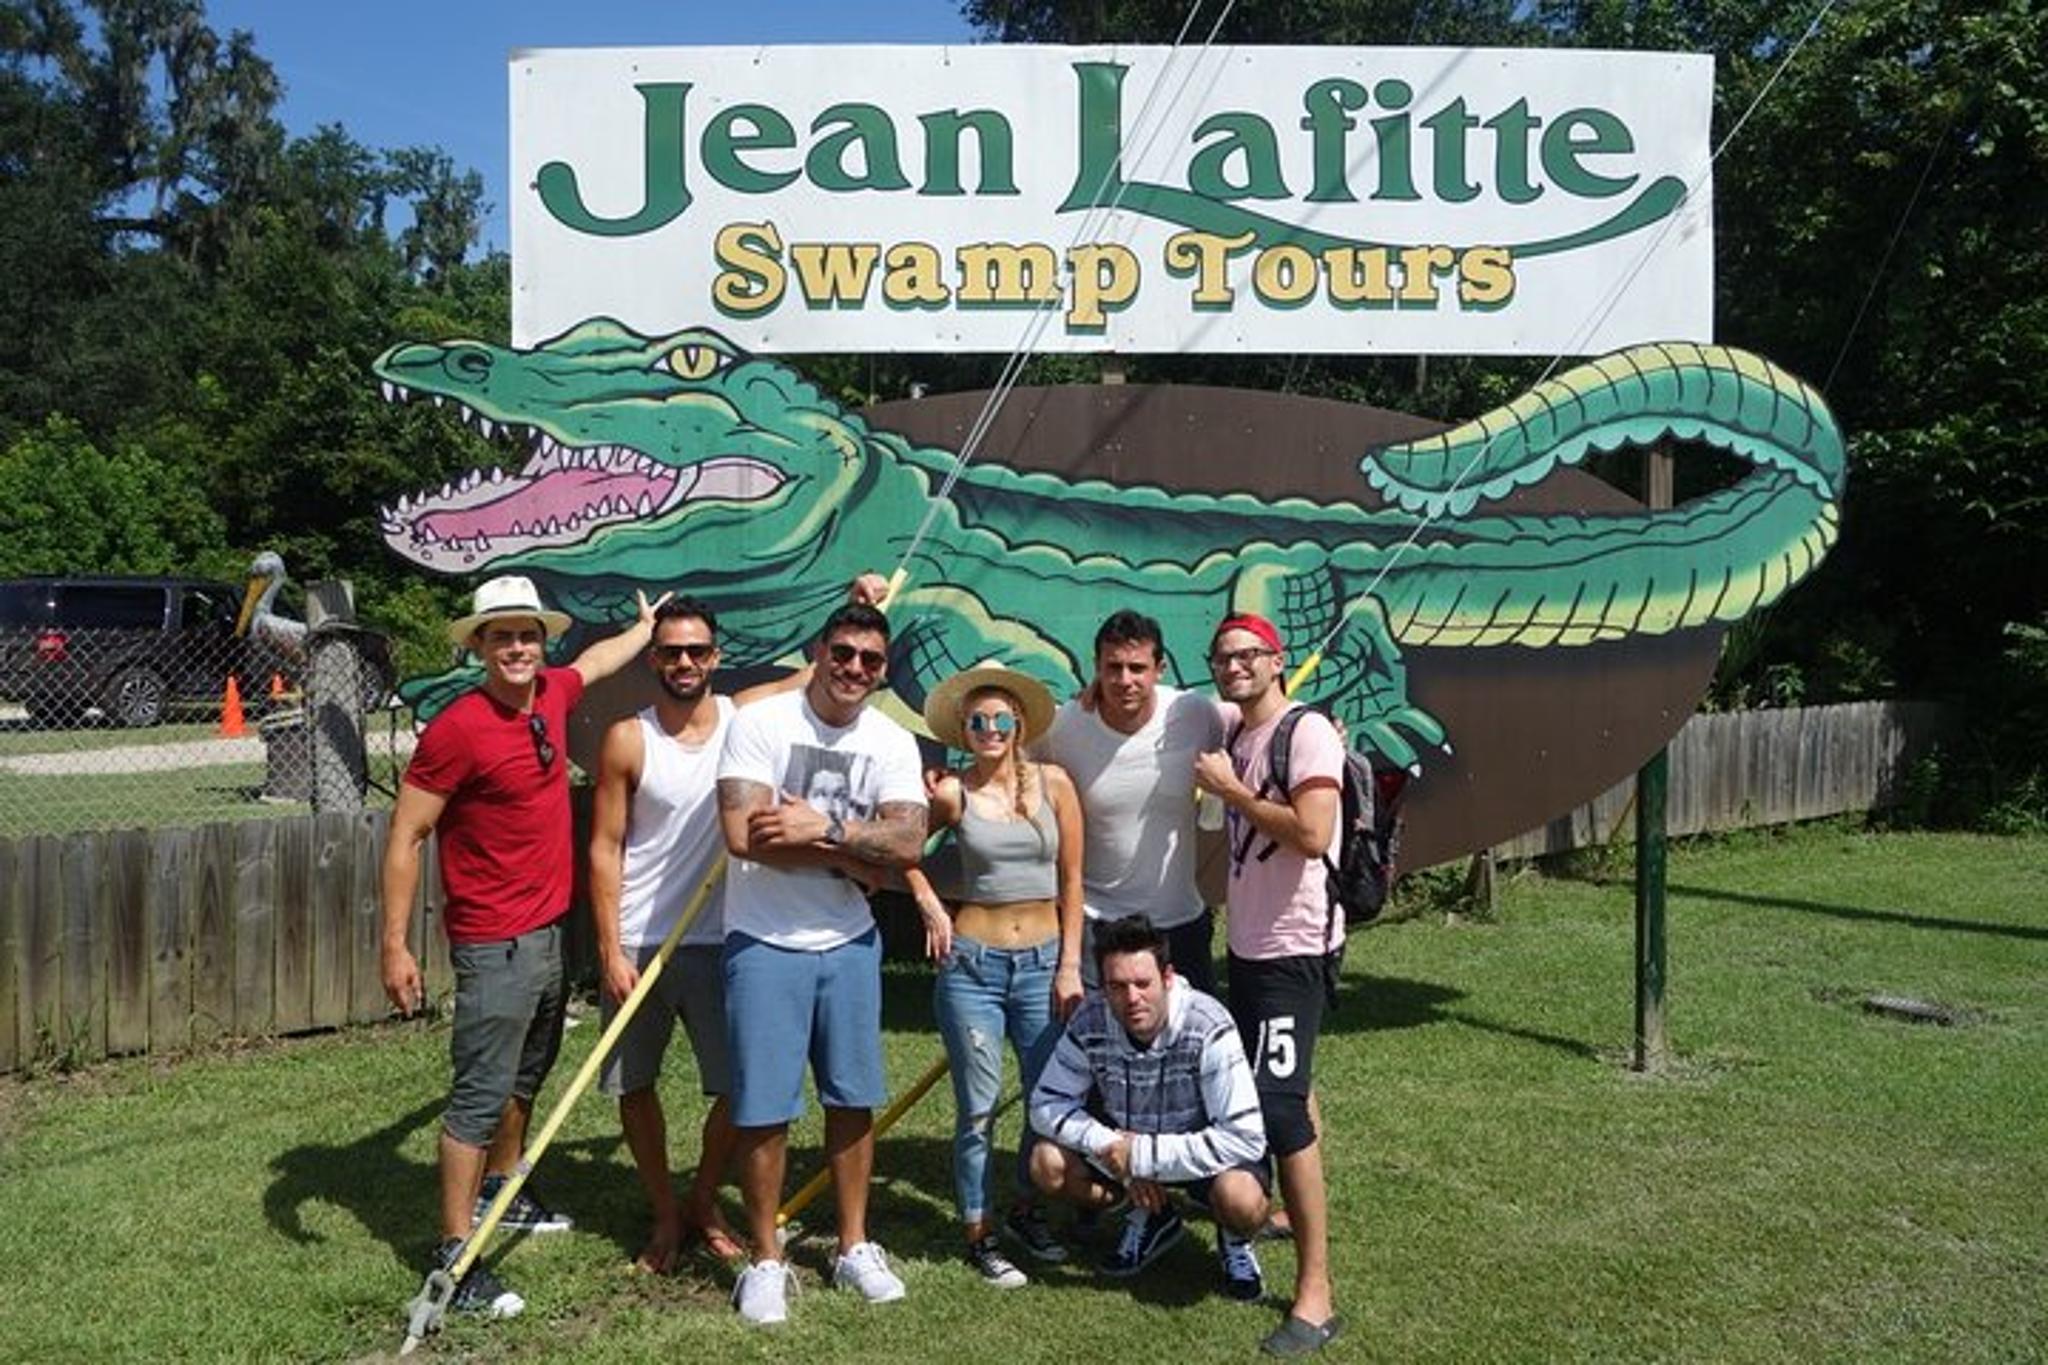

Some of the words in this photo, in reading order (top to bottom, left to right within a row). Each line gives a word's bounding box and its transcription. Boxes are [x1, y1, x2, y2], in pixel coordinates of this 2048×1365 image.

[537, 82, 1021, 237] Jean
[1056, 61, 1689, 258] Lafitte
[712, 221, 1142, 335] Swamp
[1165, 229, 1518, 311] Tours
